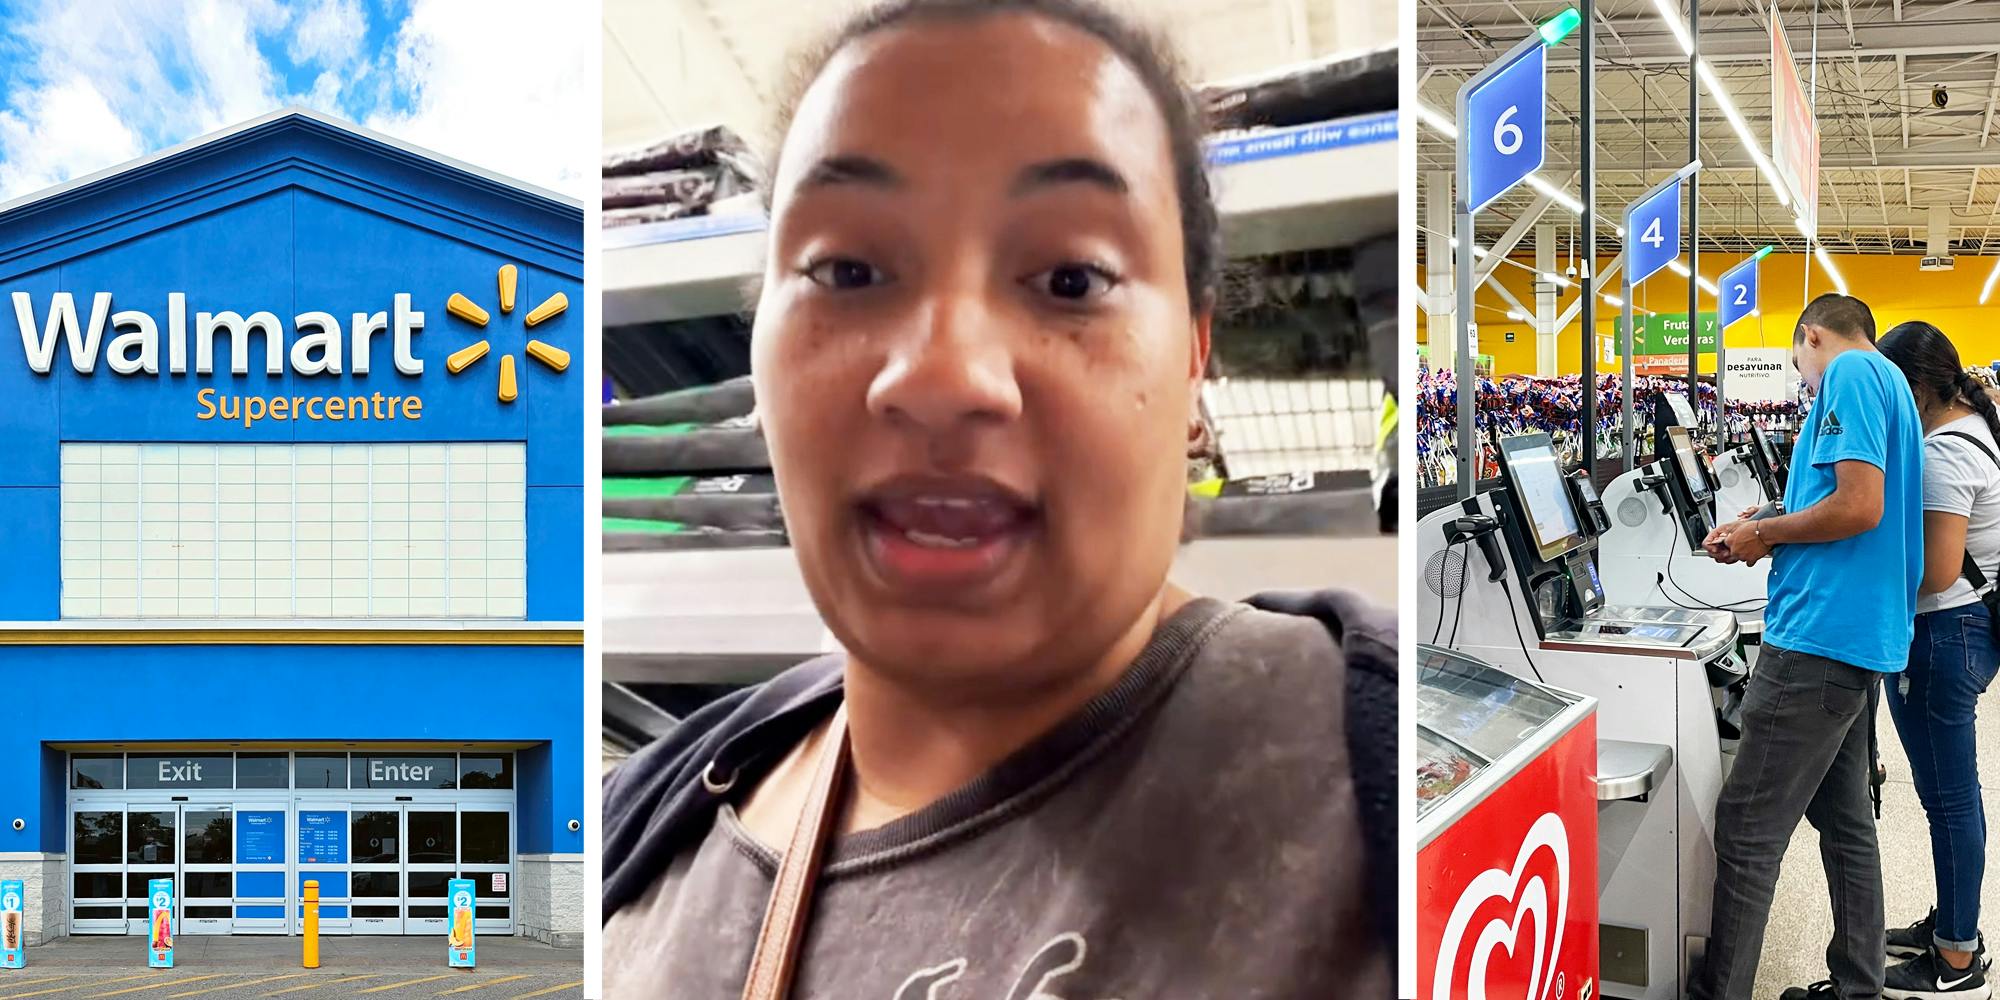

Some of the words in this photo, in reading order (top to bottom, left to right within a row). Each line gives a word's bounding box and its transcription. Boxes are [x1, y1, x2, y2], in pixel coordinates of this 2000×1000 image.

[1493, 105, 1524, 155] 6
[1641, 217, 1664, 248] 4
[1733, 284, 1747, 305] 2
[11, 291, 424, 375] Walmart
[1663, 320, 1689, 331] Fruta
[1706, 320, 1714, 331] y
[1663, 335, 1714, 346] Verdras
[196, 388, 423, 427] Supercentre
[158, 760, 202, 781] Exit
[370, 760, 434, 781] Enter
